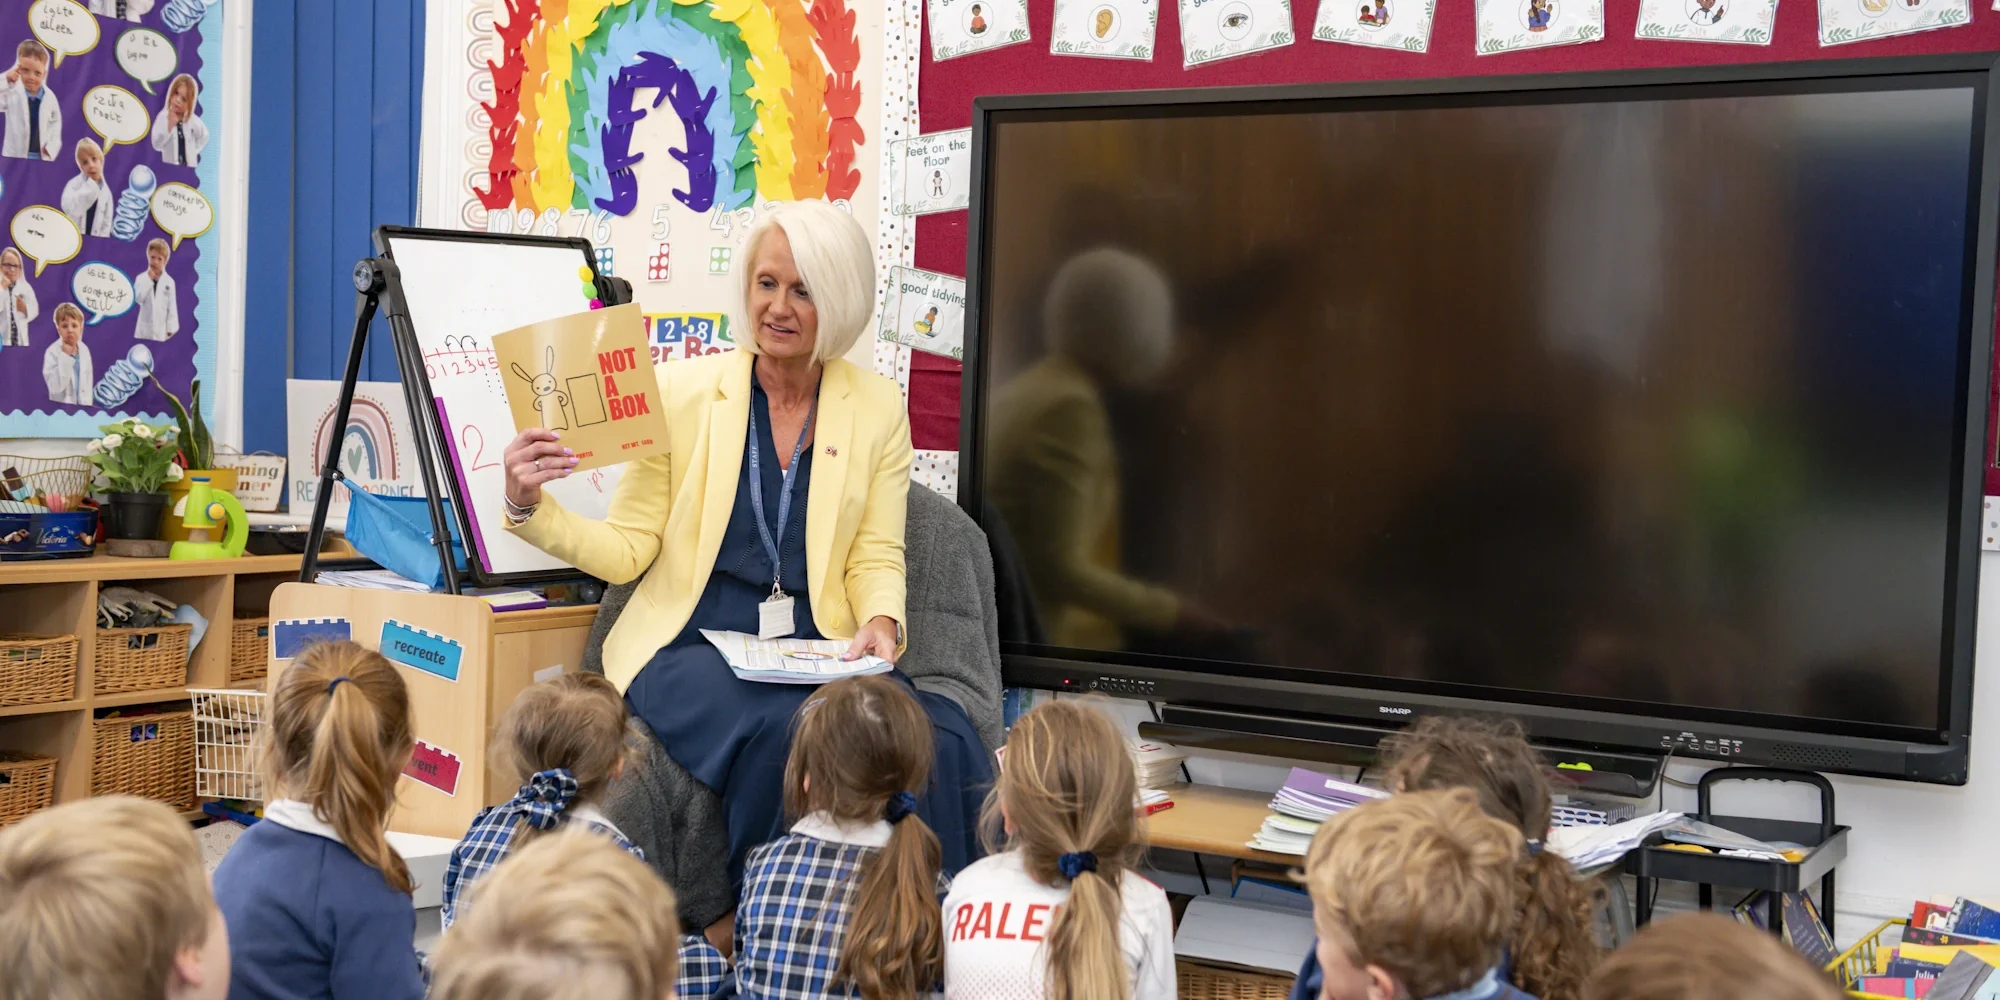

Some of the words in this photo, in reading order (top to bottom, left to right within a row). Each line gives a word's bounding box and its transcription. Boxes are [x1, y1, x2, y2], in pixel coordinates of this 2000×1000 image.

[906, 145, 928, 157] feet
[932, 145, 945, 153] on
[949, 139, 967, 151] the
[923, 155, 950, 167] floor
[517, 207, 536, 235] 9
[541, 206, 561, 237] 8
[592, 209, 611, 245] 6
[651, 204, 670, 240] 5
[710, 202, 733, 238] 4
[901, 283, 929, 296] good
[932, 288, 966, 308] tidying
[664, 320, 676, 340] 2
[697, 321, 709, 341] 8
[598, 347, 636, 375] NOT
[605, 375, 619, 398] A
[608, 392, 650, 421] BOX
[462, 424, 501, 471] 2
[36, 527, 68, 545] Victoria
[394, 640, 446, 665] recreate
[1379, 706, 1412, 715] SHARP
[411, 757, 438, 776] vent
[952, 902, 1058, 942] RALE
